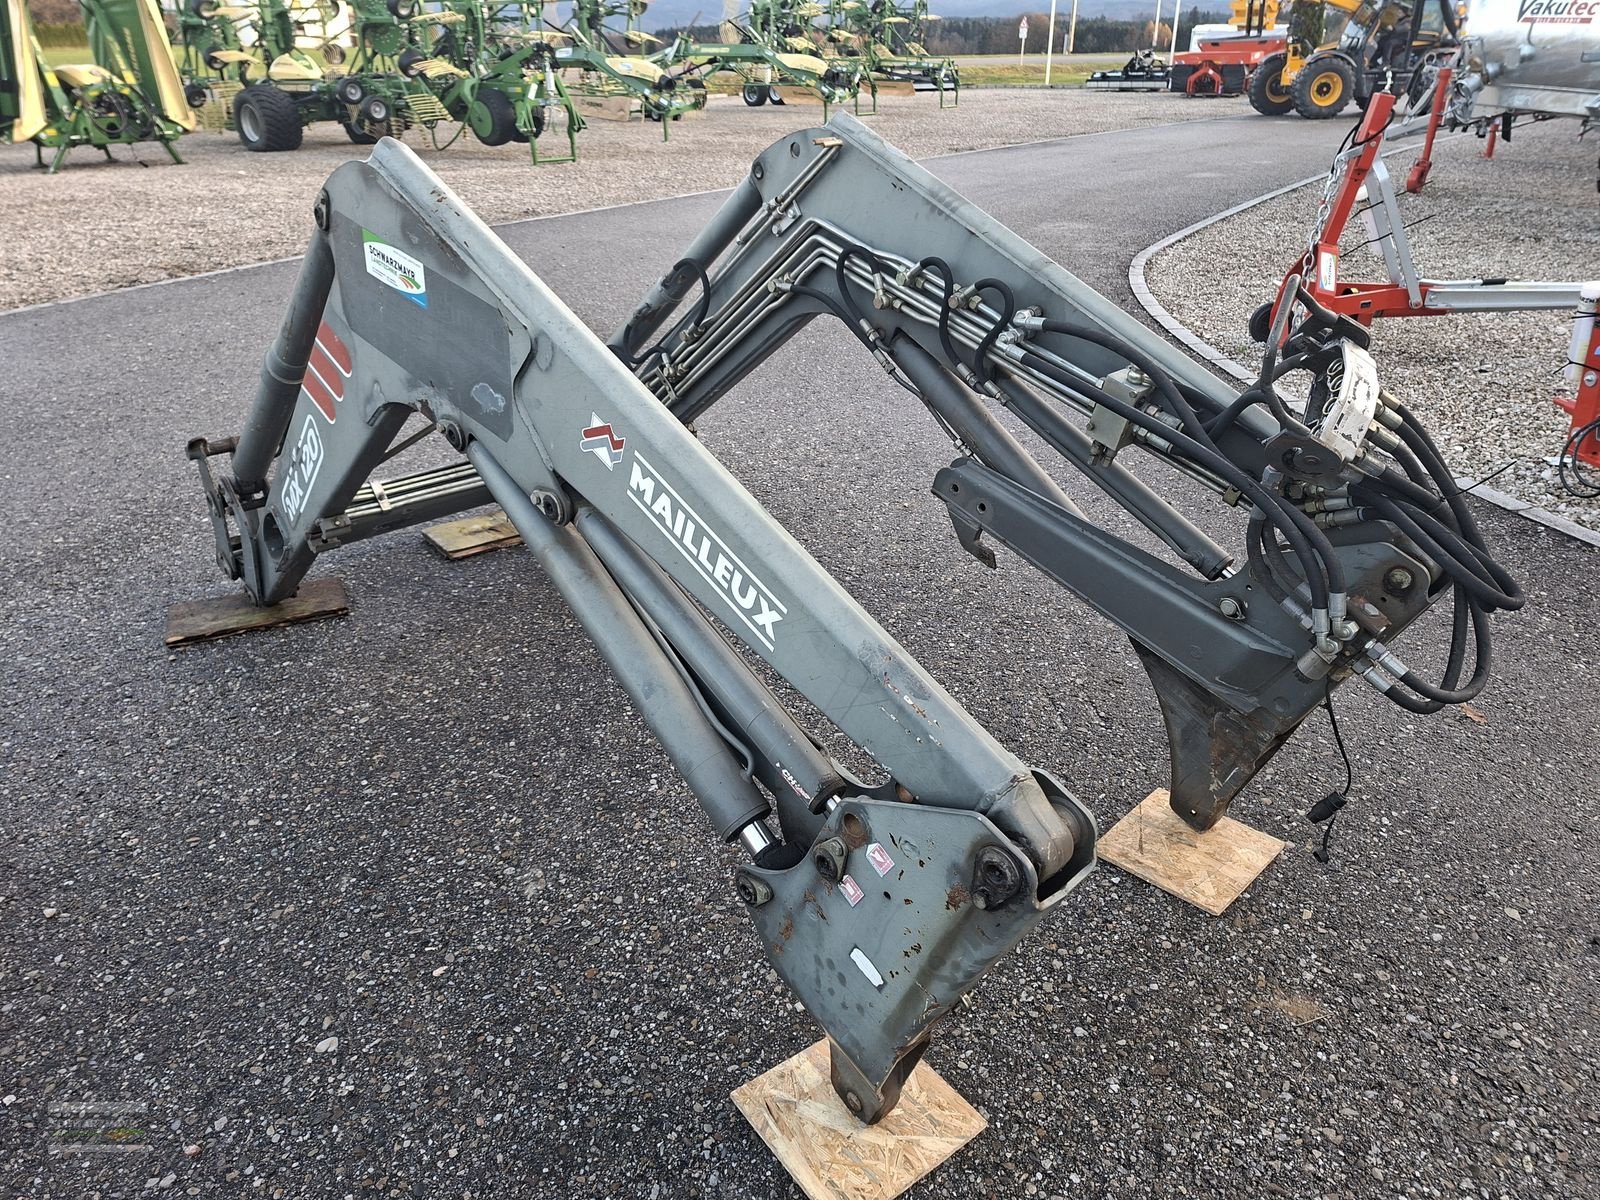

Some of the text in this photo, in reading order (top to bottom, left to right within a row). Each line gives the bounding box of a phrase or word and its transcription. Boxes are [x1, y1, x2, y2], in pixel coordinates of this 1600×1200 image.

[1517, 0, 1600, 22] Vakutec
[368, 244, 416, 280] SCHWARZMAYR
[285, 428, 319, 522] MX 120
[629, 460, 784, 642] MAILLEUX
